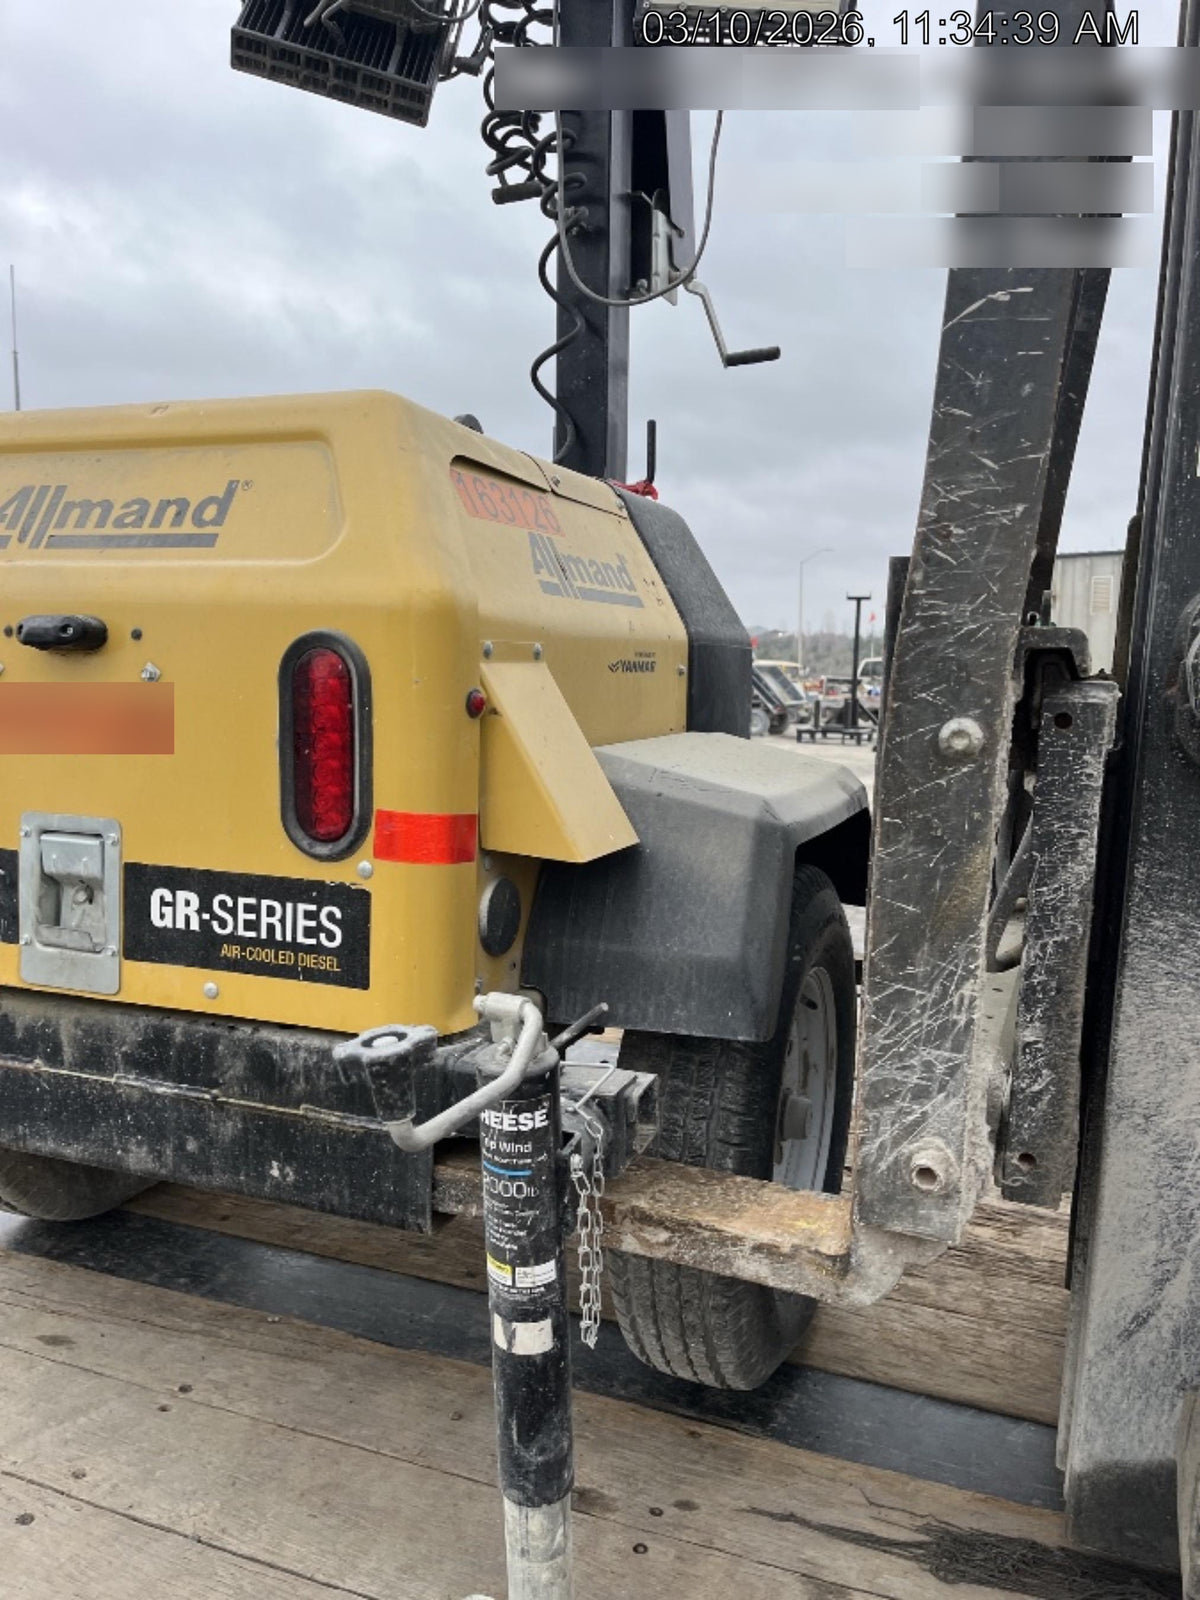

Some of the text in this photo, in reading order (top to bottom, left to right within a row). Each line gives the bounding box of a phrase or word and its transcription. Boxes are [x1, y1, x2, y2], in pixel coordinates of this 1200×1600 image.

[150, 887, 343, 948] GR-SERIES
[220, 943, 342, 972] AIR-COOLED DIESEL
